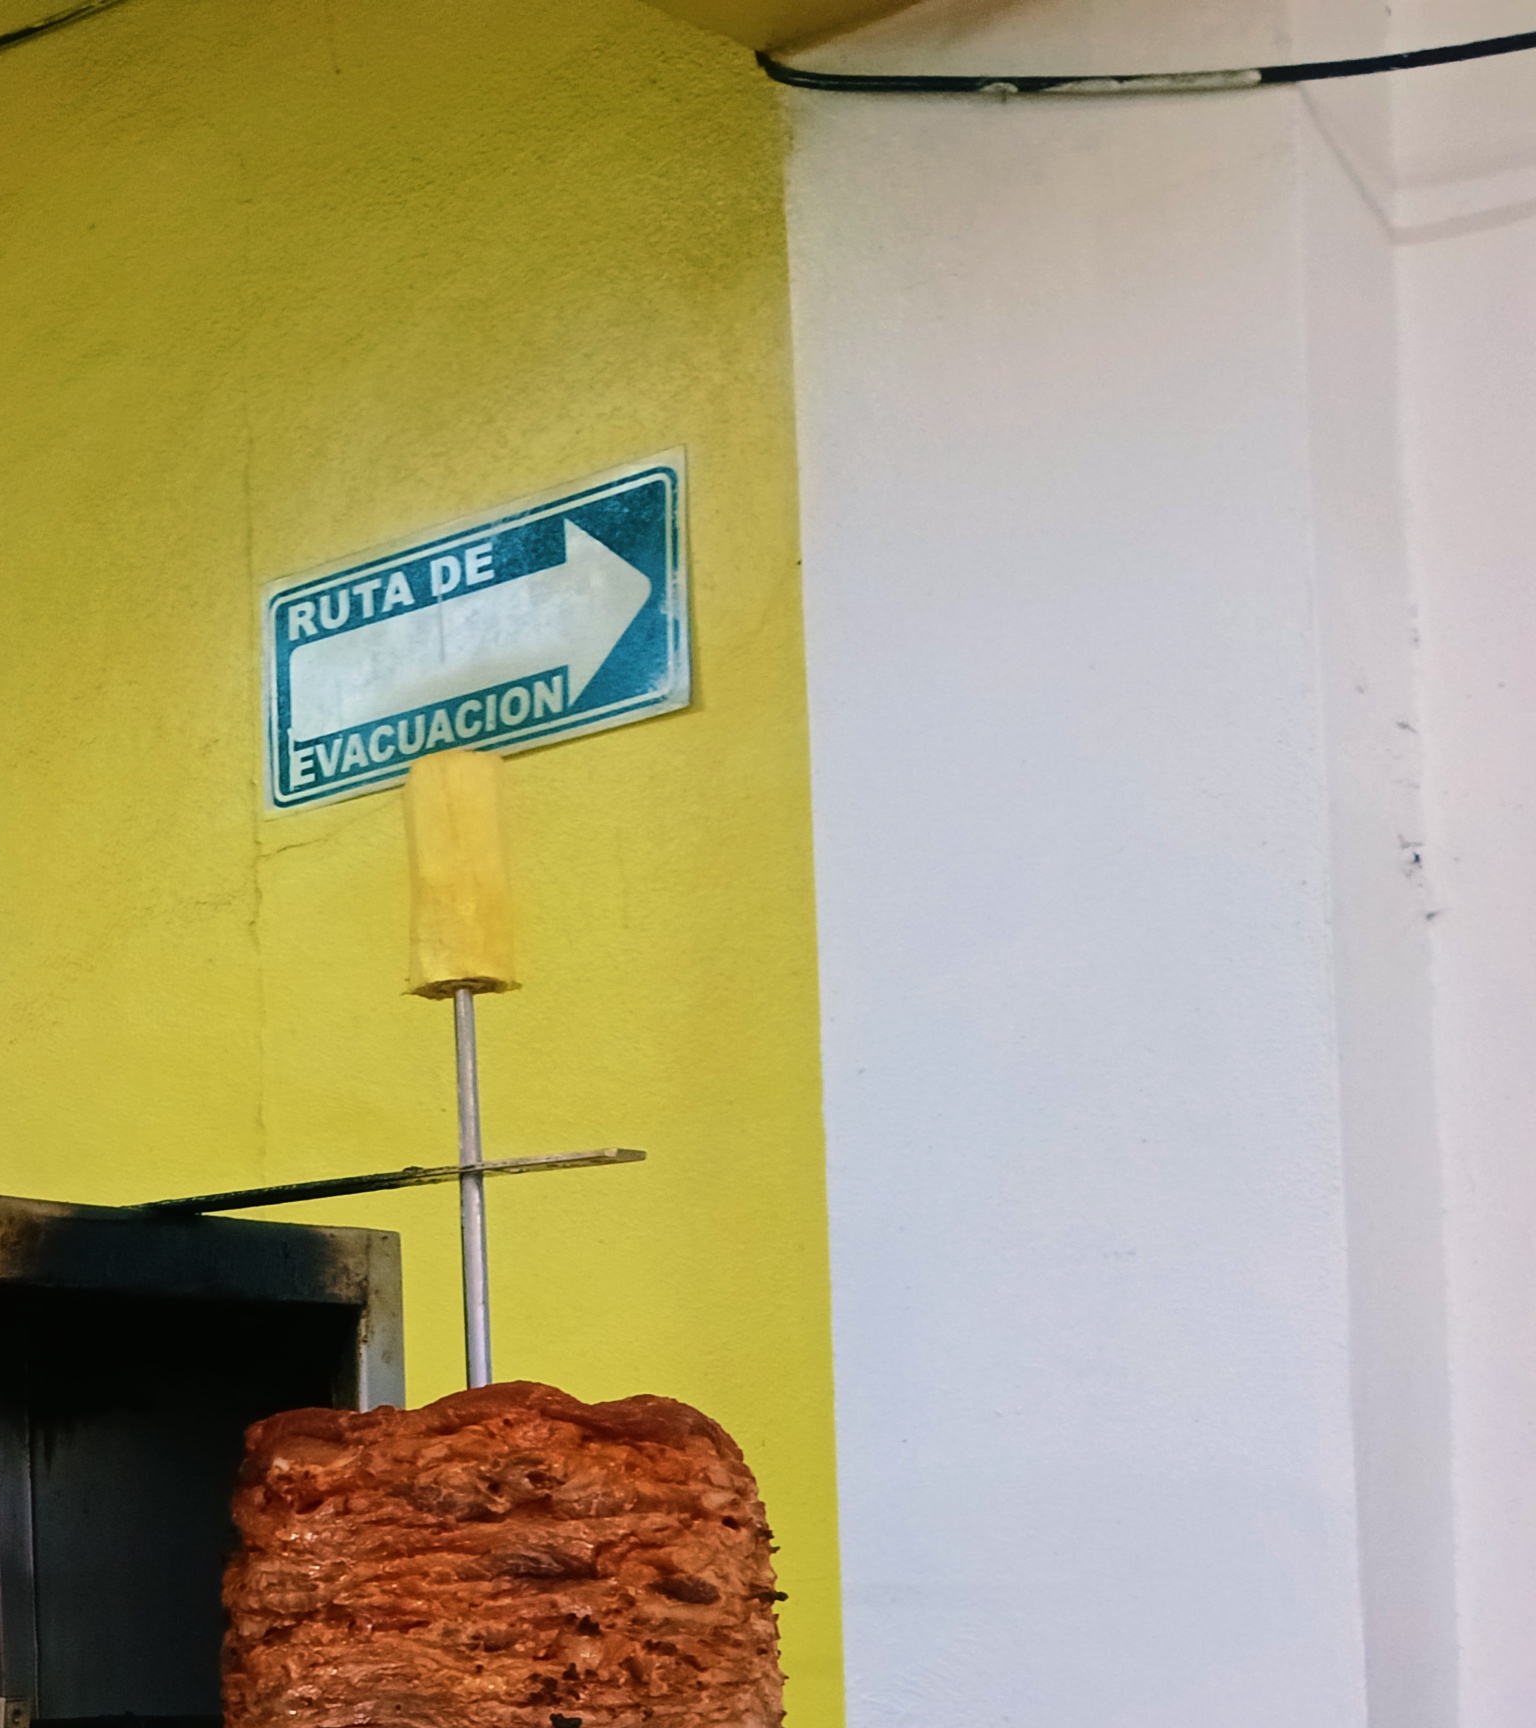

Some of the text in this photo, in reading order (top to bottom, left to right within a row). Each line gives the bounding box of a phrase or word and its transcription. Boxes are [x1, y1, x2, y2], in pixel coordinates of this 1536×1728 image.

[288, 542, 495, 640] RUTA DE
[289, 676, 565, 790] EVACUACION
